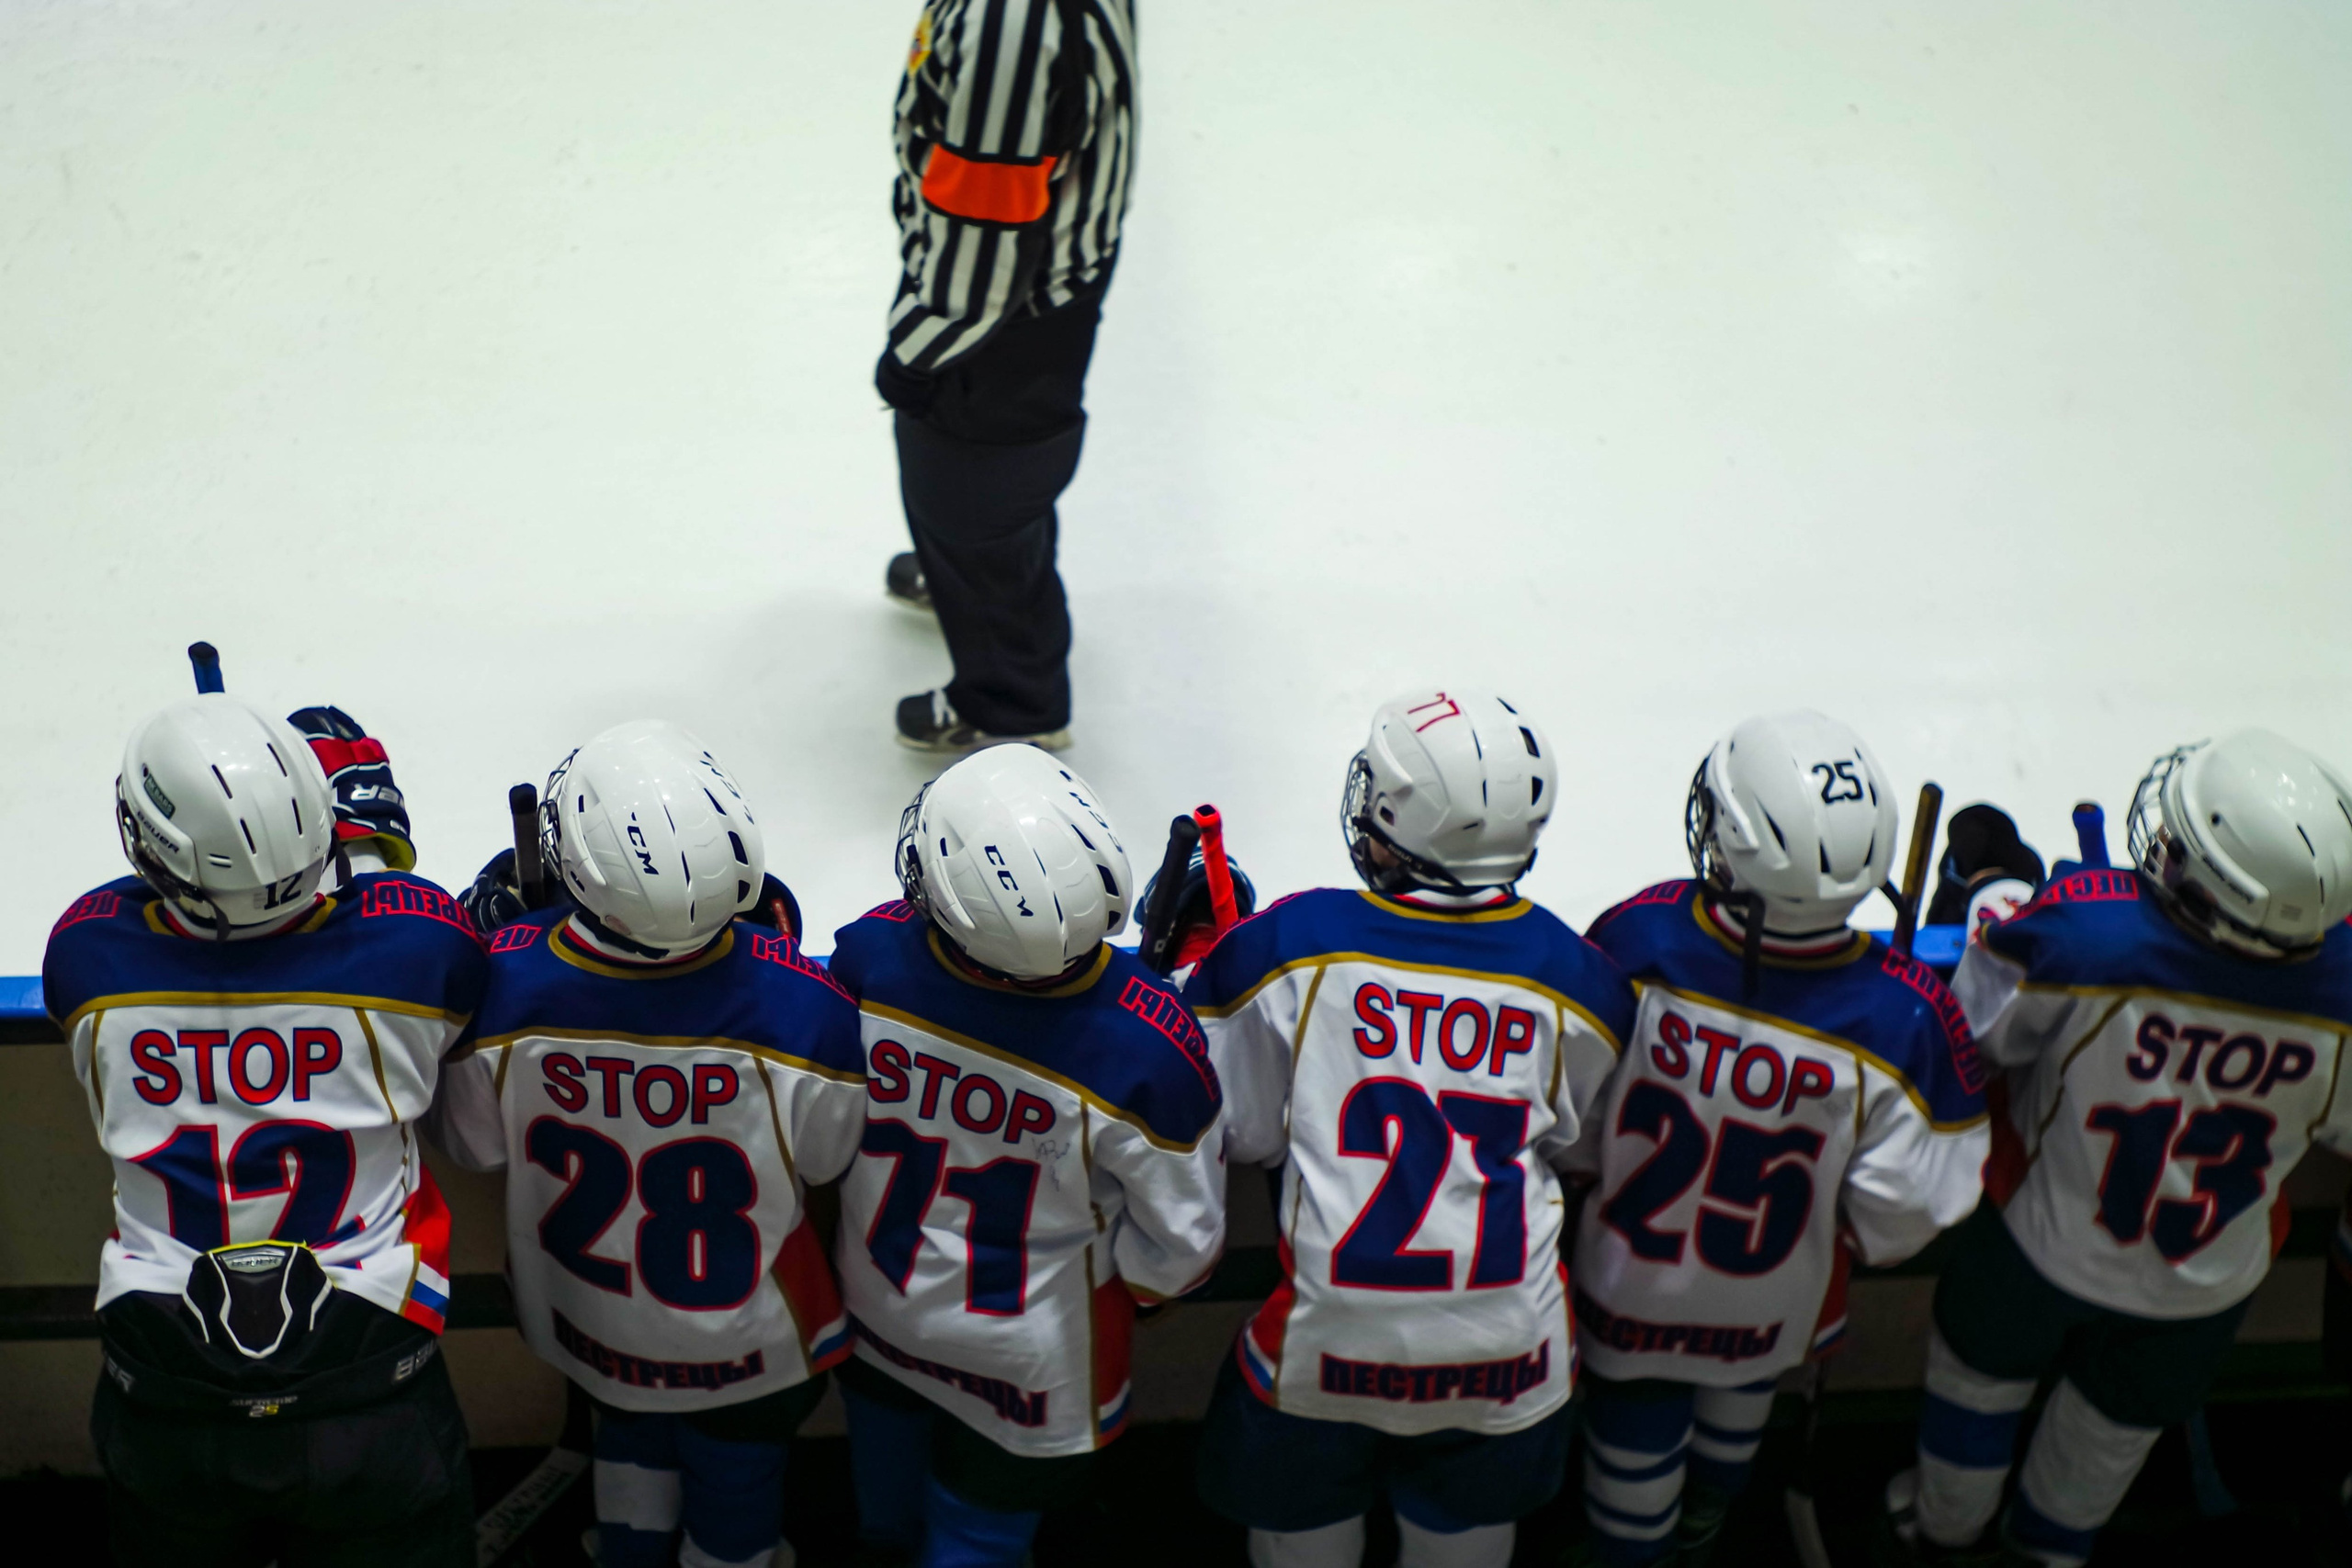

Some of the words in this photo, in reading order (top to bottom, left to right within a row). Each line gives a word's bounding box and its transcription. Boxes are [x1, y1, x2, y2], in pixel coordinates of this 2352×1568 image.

[1811, 760, 1865, 806] 25
[628, 812, 660, 876] CM
[984, 844, 1035, 917] CCM
[263, 871, 304, 910] 12
[130, 1027, 343, 1106] STOP
[1352, 982, 1536, 1077] STOP
[1651, 1010, 1835, 1116] STOP
[2126, 1014, 2316, 1098] STOP
[541, 1053, 740, 1128] STOP
[867, 1039, 1057, 1145] STOP
[127, 1118, 366, 1249] 12
[526, 1115, 761, 1312] 28
[860, 1118, 1041, 1317] 71
[1599, 1077, 1826, 1279] 25
[2085, 1098, 2278, 1268] 13
[551, 1306, 765, 1391] ПЕСТРЕЦЫ
[1320, 1337, 1550, 1406] ПЕСТРЕЦЫ
